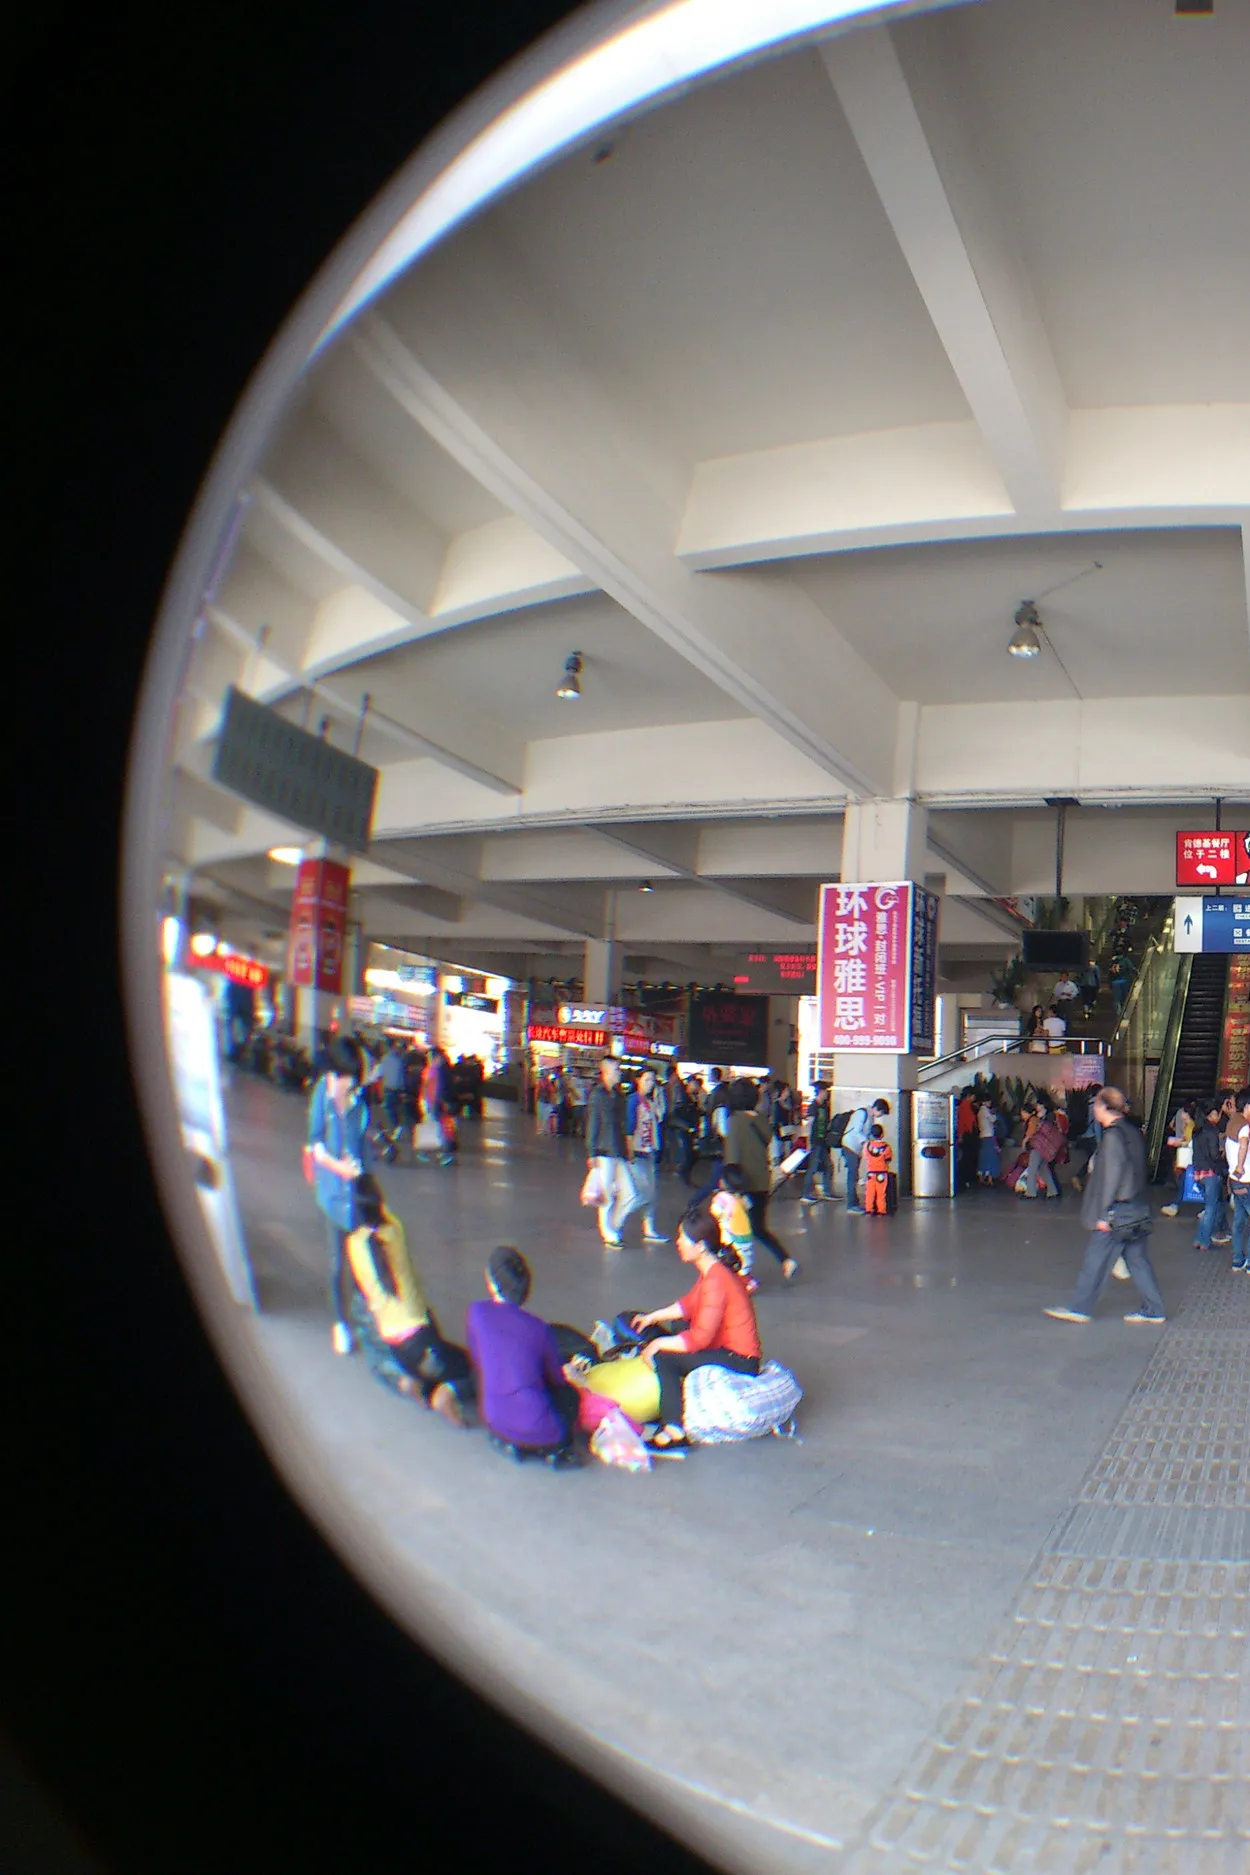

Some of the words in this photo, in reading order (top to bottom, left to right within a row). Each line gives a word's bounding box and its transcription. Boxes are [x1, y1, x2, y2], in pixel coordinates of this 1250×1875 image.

[1184, 838, 1230, 849] 肯德基餐厅
[1184, 849, 1230, 859] 位于二楼
[833, 886, 869, 1031] 环球雅思
